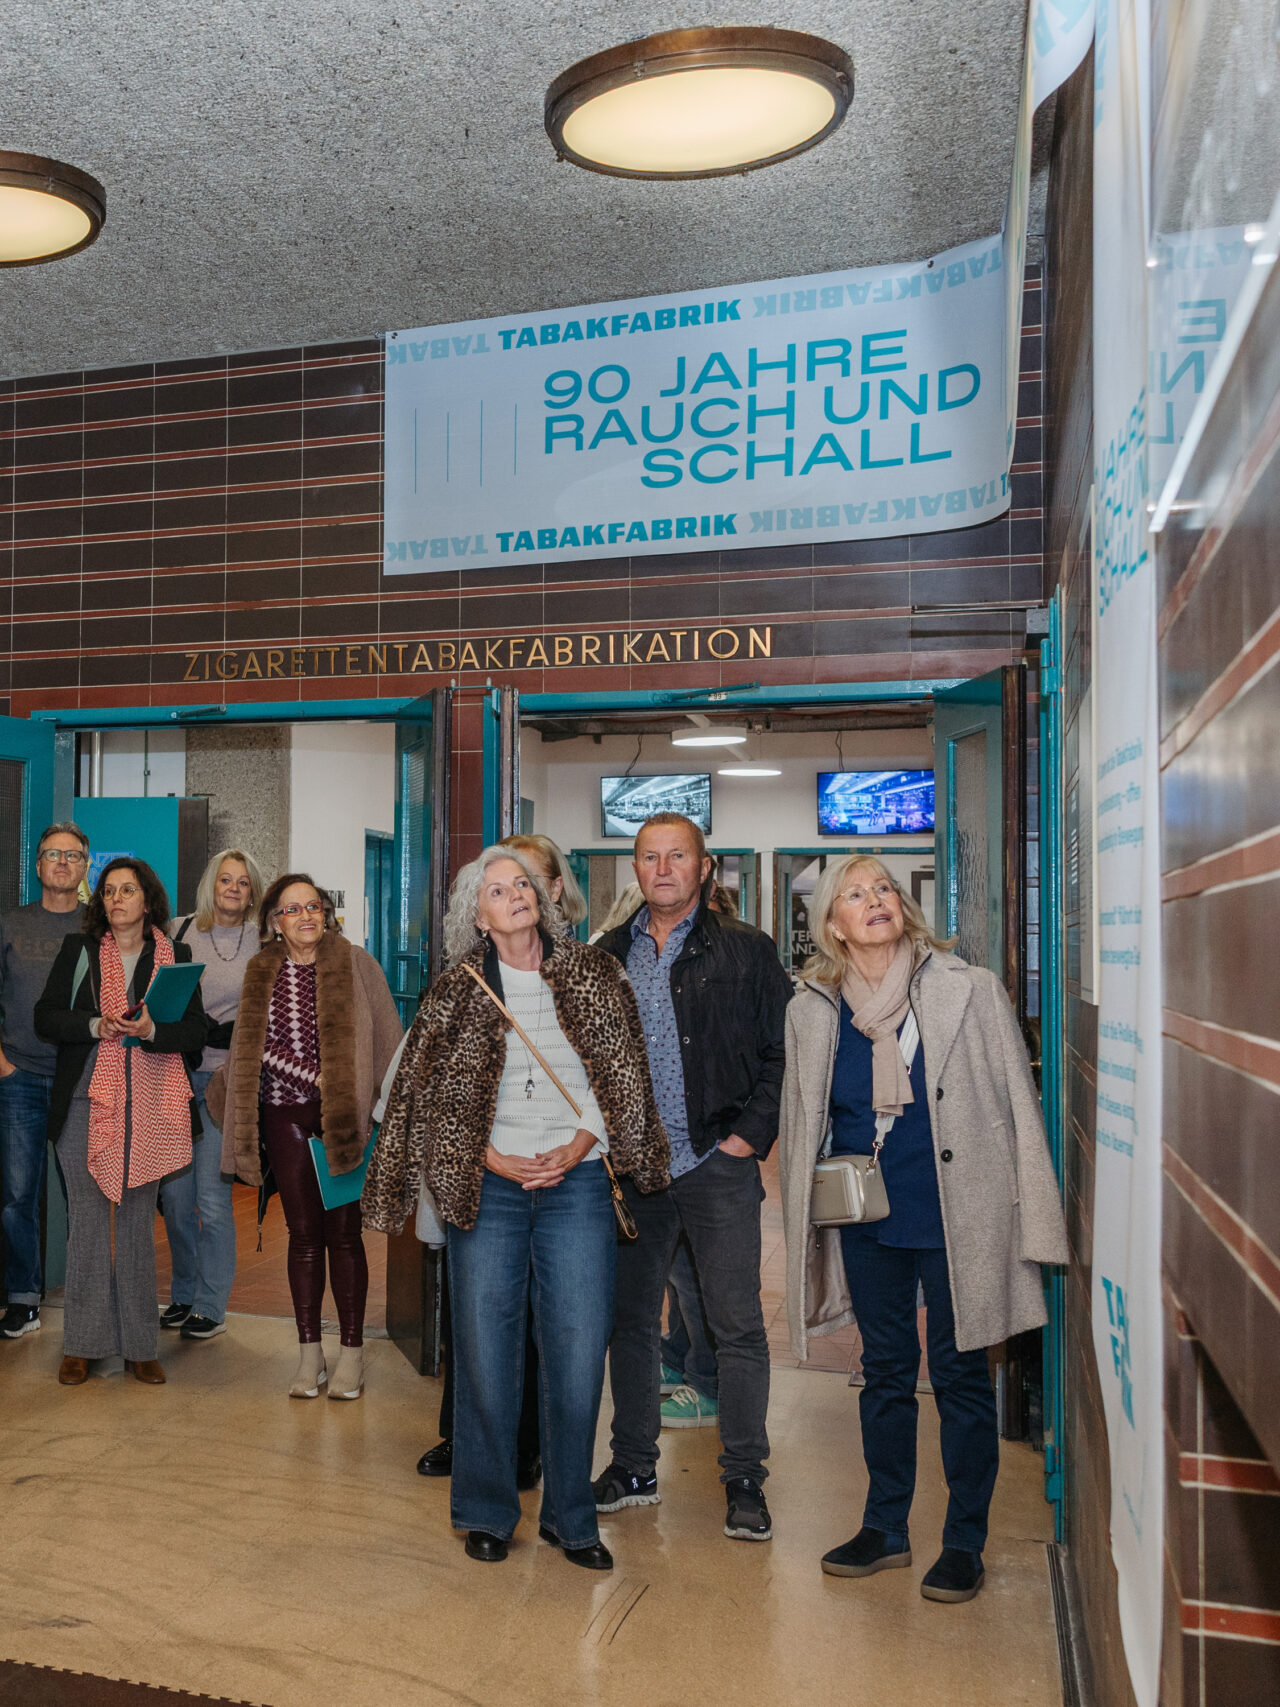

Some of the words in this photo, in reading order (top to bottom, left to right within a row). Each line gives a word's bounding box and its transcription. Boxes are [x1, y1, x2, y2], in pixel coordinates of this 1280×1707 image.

[752, 247, 1002, 318] TABAKFABRIK
[386, 333, 491, 365] TABAK
[498, 299, 741, 350] TABAKFABRIK
[544, 364, 630, 409] 90
[660, 329, 907, 398] JAHRE
[545, 390, 795, 454] RAUCH
[824, 364, 980, 424] UND
[640, 422, 952, 488] SCHALL
[496, 514, 736, 552] TABAKFABRIK
[749, 482, 997, 533] TABAKFABRIK
[385, 535, 489, 562] TABAK
[183, 626, 771, 681] ZIGARETTENTABAKFABRIKATION
